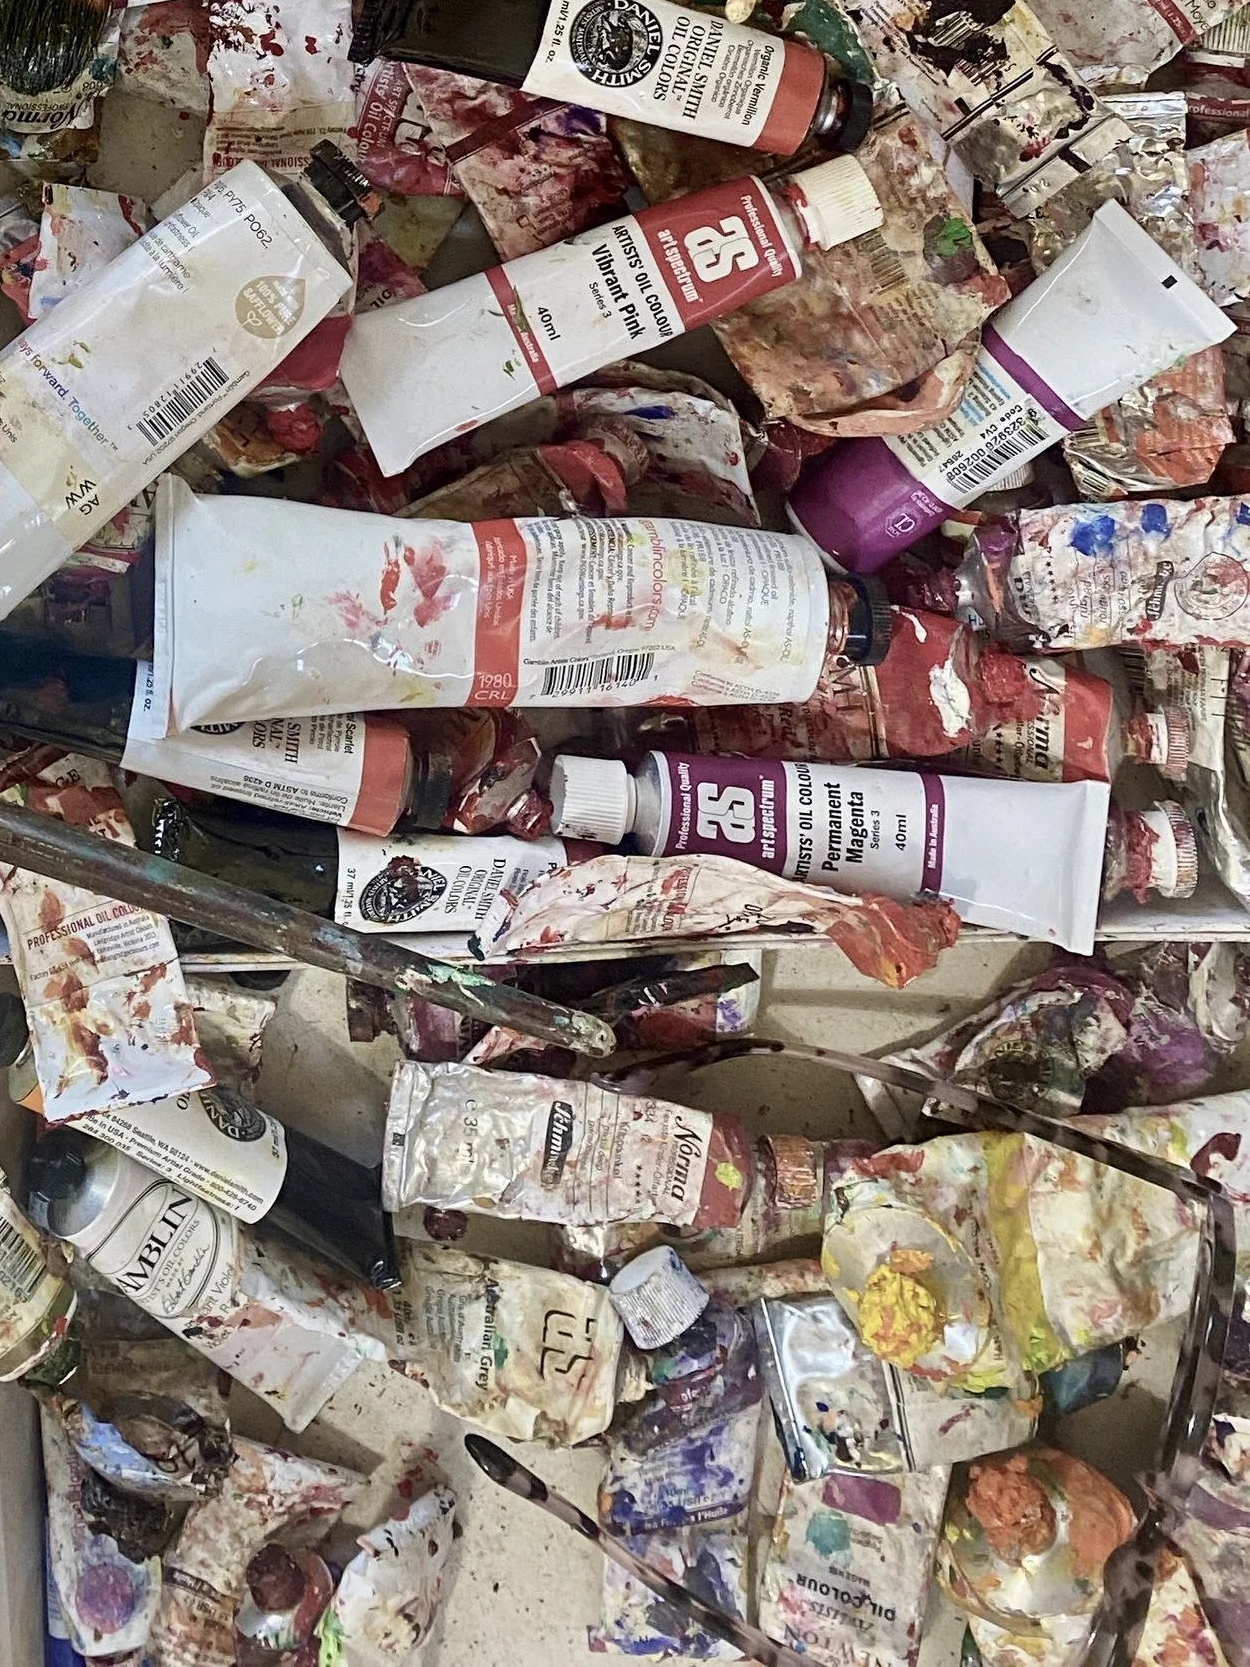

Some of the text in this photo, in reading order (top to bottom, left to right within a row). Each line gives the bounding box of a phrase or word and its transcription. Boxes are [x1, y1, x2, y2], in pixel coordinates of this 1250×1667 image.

[552, 1, 572, 36] ml/1.25
[592, 45, 651, 97] SMITH
[653, 16, 691, 101] OIL COLORS
[682, 21, 724, 119] DANIEL SMITH
[742, 45, 776, 126] Organic Vermilion
[366, 101, 384, 122] Oil
[739, 195, 784, 277] Professional Quality
[588, 281, 612, 319] Series 3
[591, 245, 646, 339] Vibrant Pink
[612, 224, 673, 339] ARTISTS' OIL COLOUR
[236, 287, 290, 334] SAFFLOWER
[252, 279, 298, 326] 100% PURE
[535, 304, 560, 341] 40ml
[28, 354, 73, 398] forward.
[141, 362, 202, 418] 29911 12805
[979, 422, 998, 441] CV4
[61, 476, 96, 509] WW
[79, 494, 102, 516] AG
[474, 687, 510, 703] CRL
[477, 671, 511, 691] 1980
[282, 721, 303, 764] SMITH
[341, 722, 357, 754] Scarlet
[271, 782, 299, 794] ASTM
[674, 761, 694, 849] Professional Quality
[797, 808, 814, 830] OIL
[817, 783, 846, 871] Permanent
[842, 790, 871, 864] Magenta
[870, 819, 882, 849] Series
[893, 814, 908, 851] 40ml
[344, 867, 357, 880] 37
[443, 864, 472, 915] OIL COLORS
[473, 857, 506, 921] DANIEL SMITH
[25, 909, 111, 950] PROFESSIONAL OIL
[107, 1125, 123, 1140] USA
[676, 1115, 709, 1204] Norma
[473, 1353, 492, 1391] Grey
[792, 1574, 864, 1608] COLOUR
